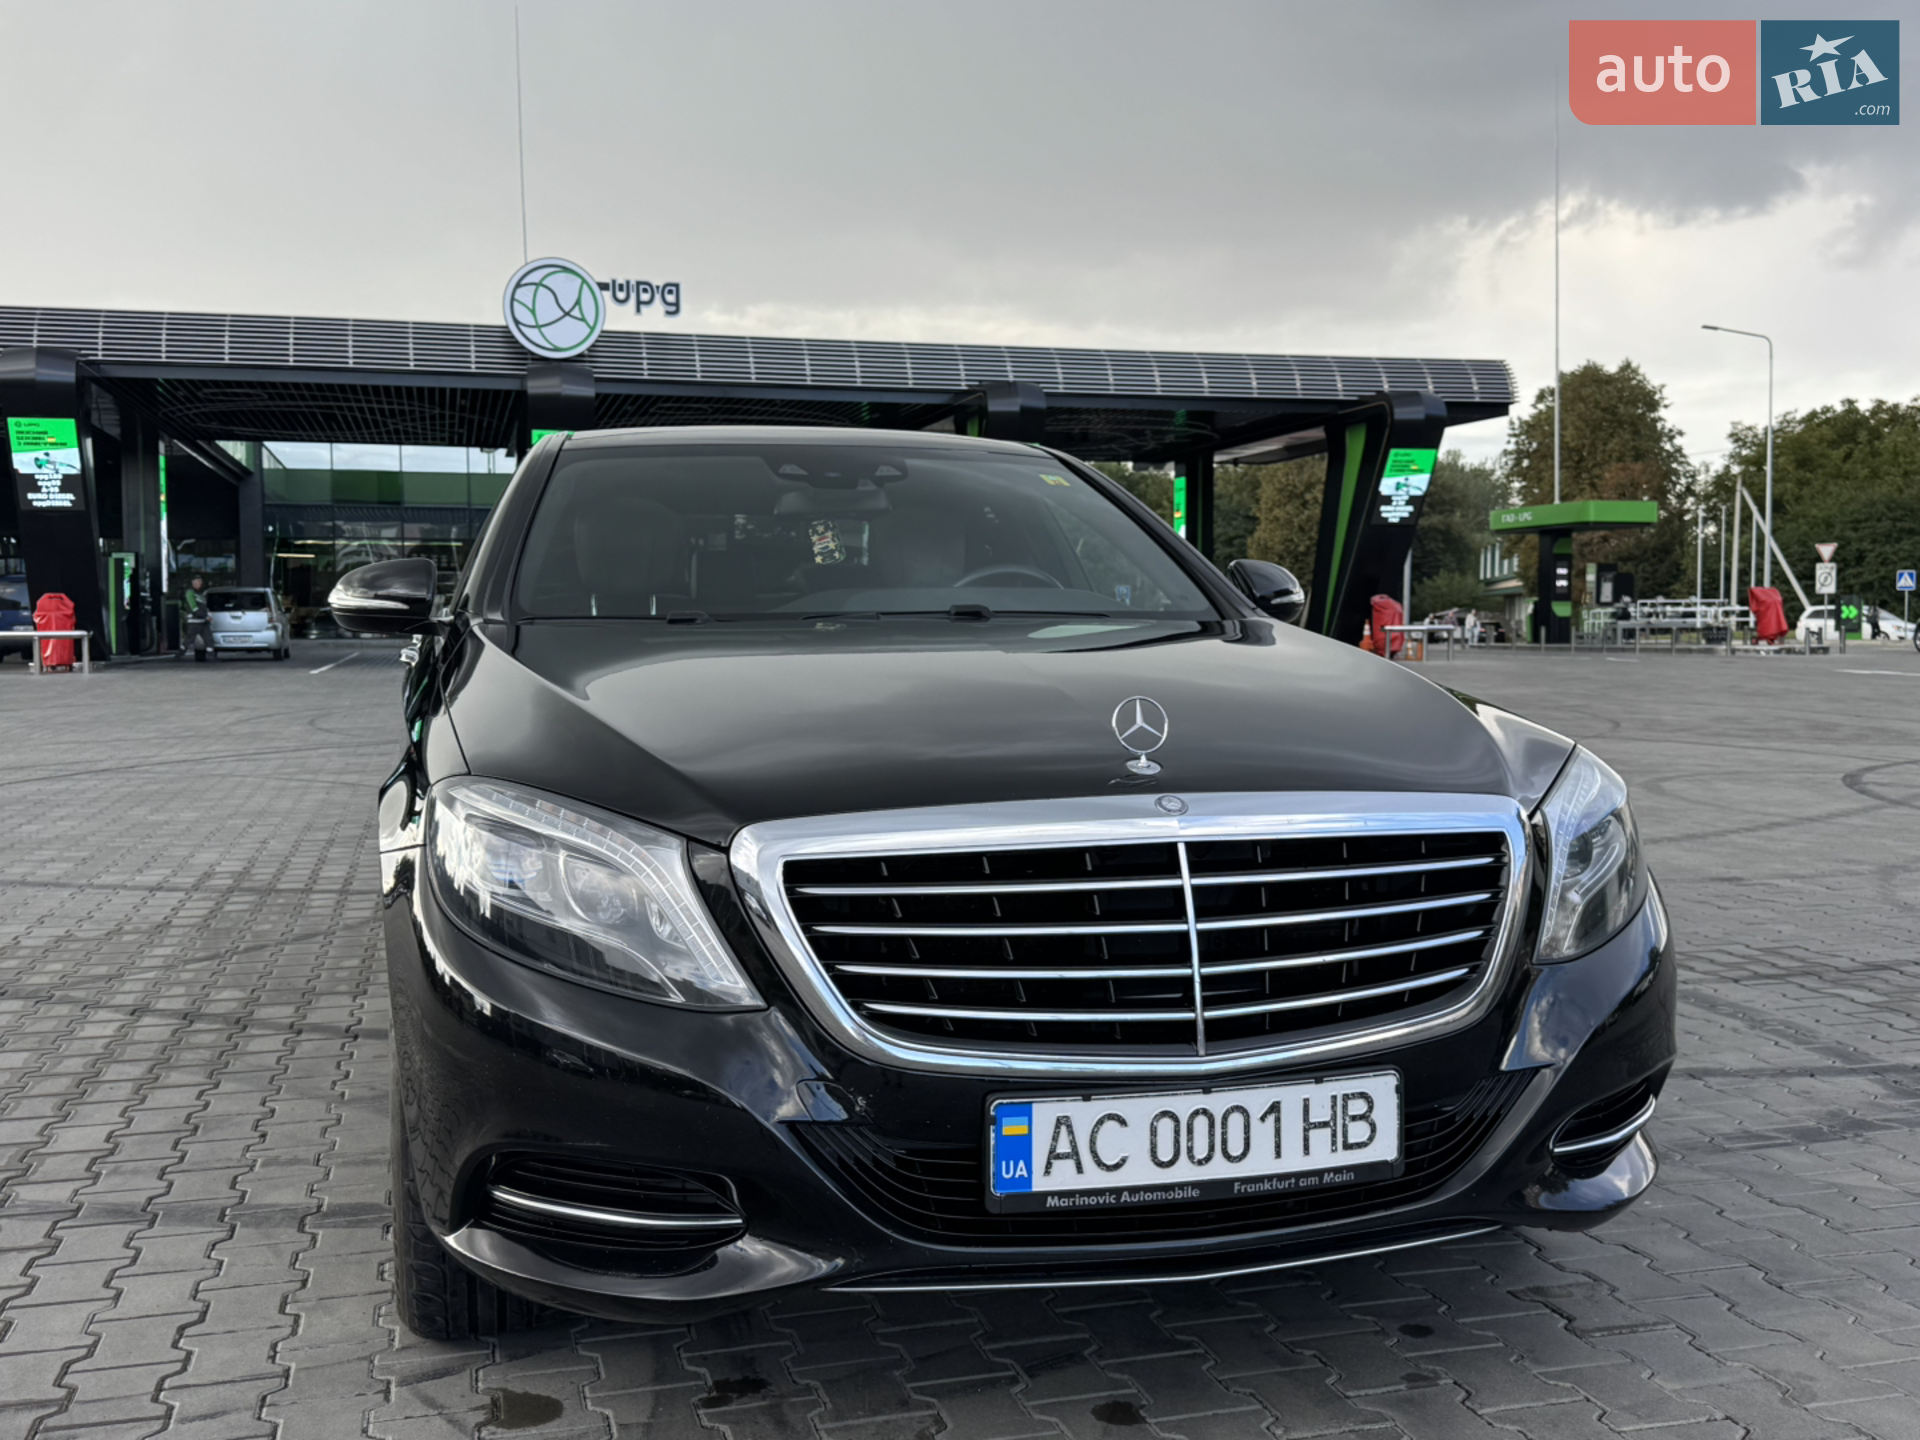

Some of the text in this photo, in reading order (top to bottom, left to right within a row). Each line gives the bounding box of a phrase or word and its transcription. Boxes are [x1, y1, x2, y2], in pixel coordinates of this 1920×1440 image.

[610, 278, 682, 318] upg
[1043, 1089, 1378, 1177] AC 0001 HB
[1001, 1159, 1029, 1179] UA
[1046, 1170, 1355, 1208] Marinovic Automobile Frankfurt am Main
